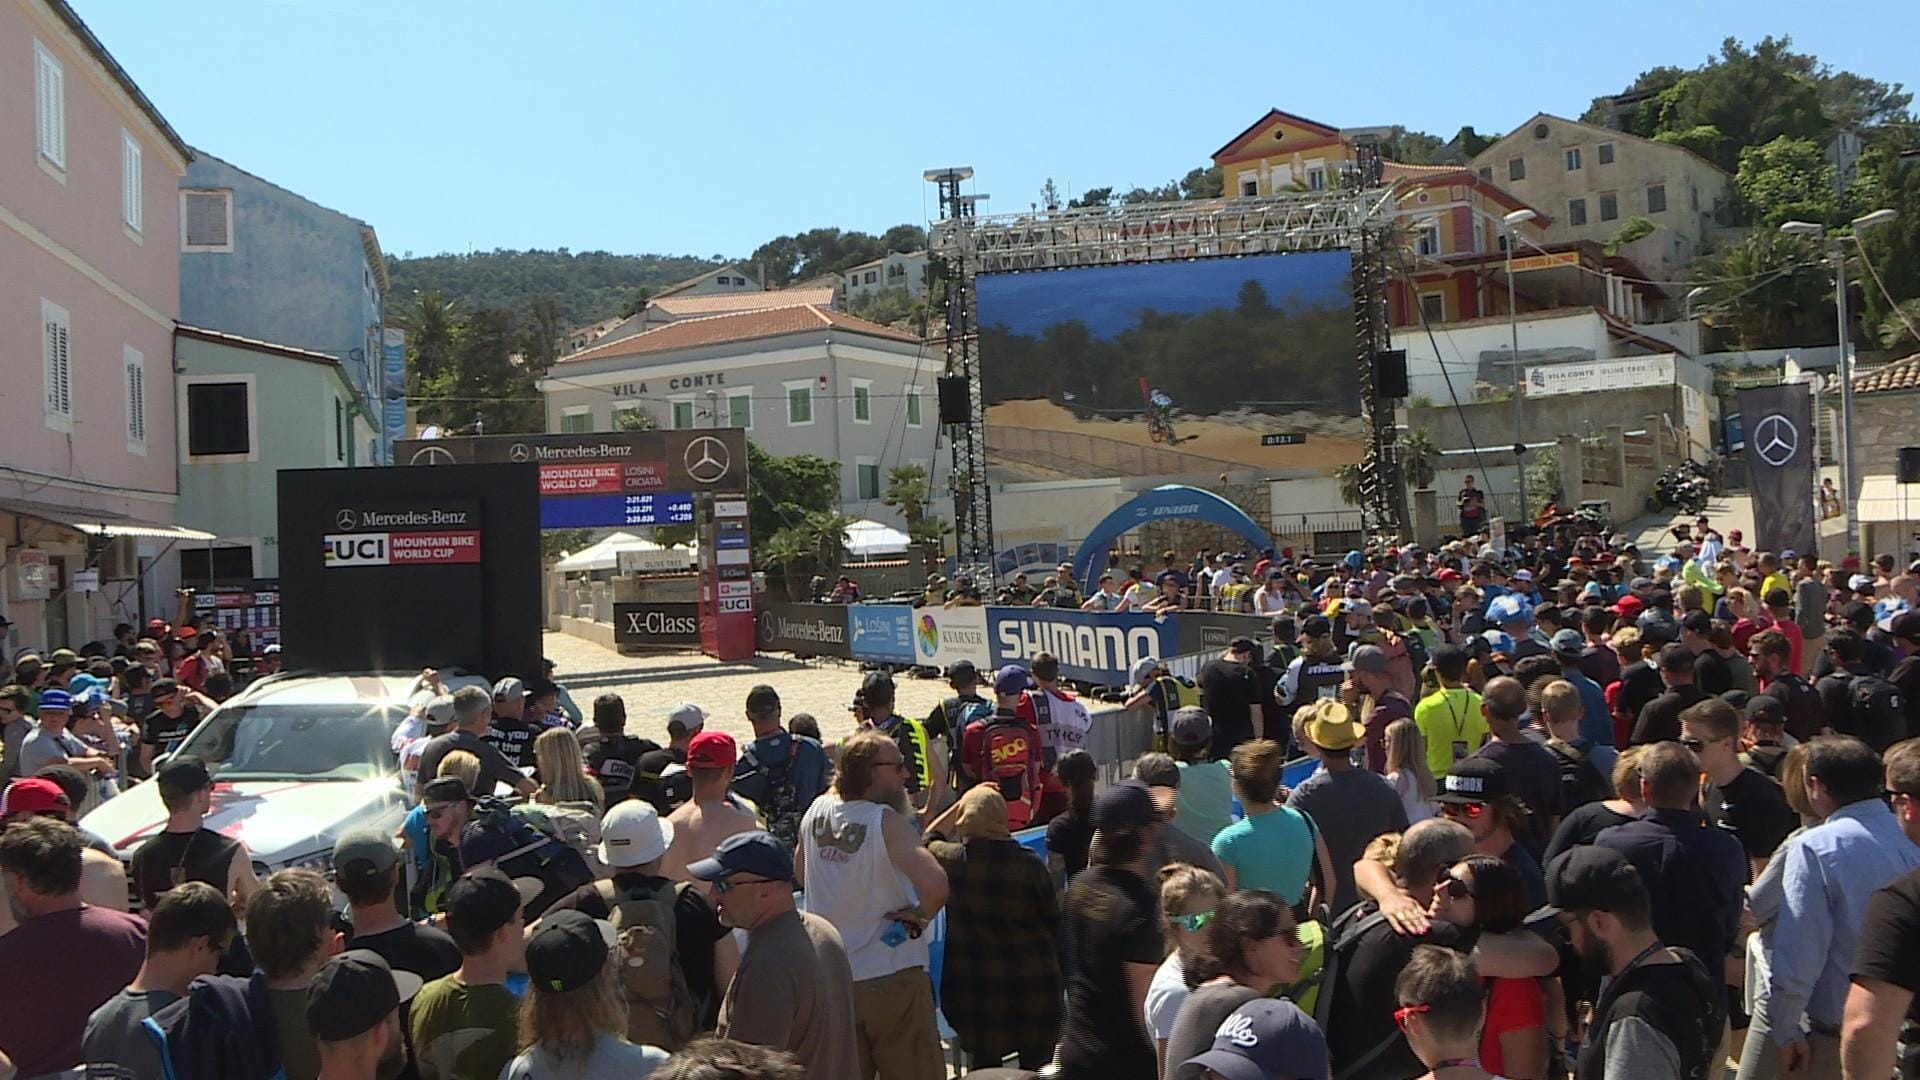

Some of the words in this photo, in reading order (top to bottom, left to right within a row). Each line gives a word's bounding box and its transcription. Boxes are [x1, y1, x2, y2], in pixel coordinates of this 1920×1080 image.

[1548, 370, 1566, 380] VILA
[1567, 369, 1594, 378] CONTE
[613, 382, 648, 397] VILA
[669, 373, 725, 390] CONTE
[535, 445, 632, 460] Mercedes-Benz
[541, 468, 594, 479] MOUNTAIN
[595, 467, 617, 478] BIKE
[541, 480, 577, 490] WORLD
[578, 479, 598, 488] CUP
[625, 477, 663, 487] CROATIA
[362, 509, 467, 527] Mercedes-Benz
[393, 537, 450, 548] MOUNTAIN
[451, 536, 475, 546] BIKE
[335, 539, 384, 560] UCI
[393, 548, 432, 559] WORLD
[433, 548, 455, 558] CUP
[724, 599, 750, 610] UCI
[626, 611, 696, 634] X-Class
[777, 616, 844, 644] Mercedes-Benz
[942, 630, 983, 646] KVARNER
[998, 620, 1160, 672] SHIMANO
[507, 730, 530, 742] you
[501, 741, 522, 753] the
